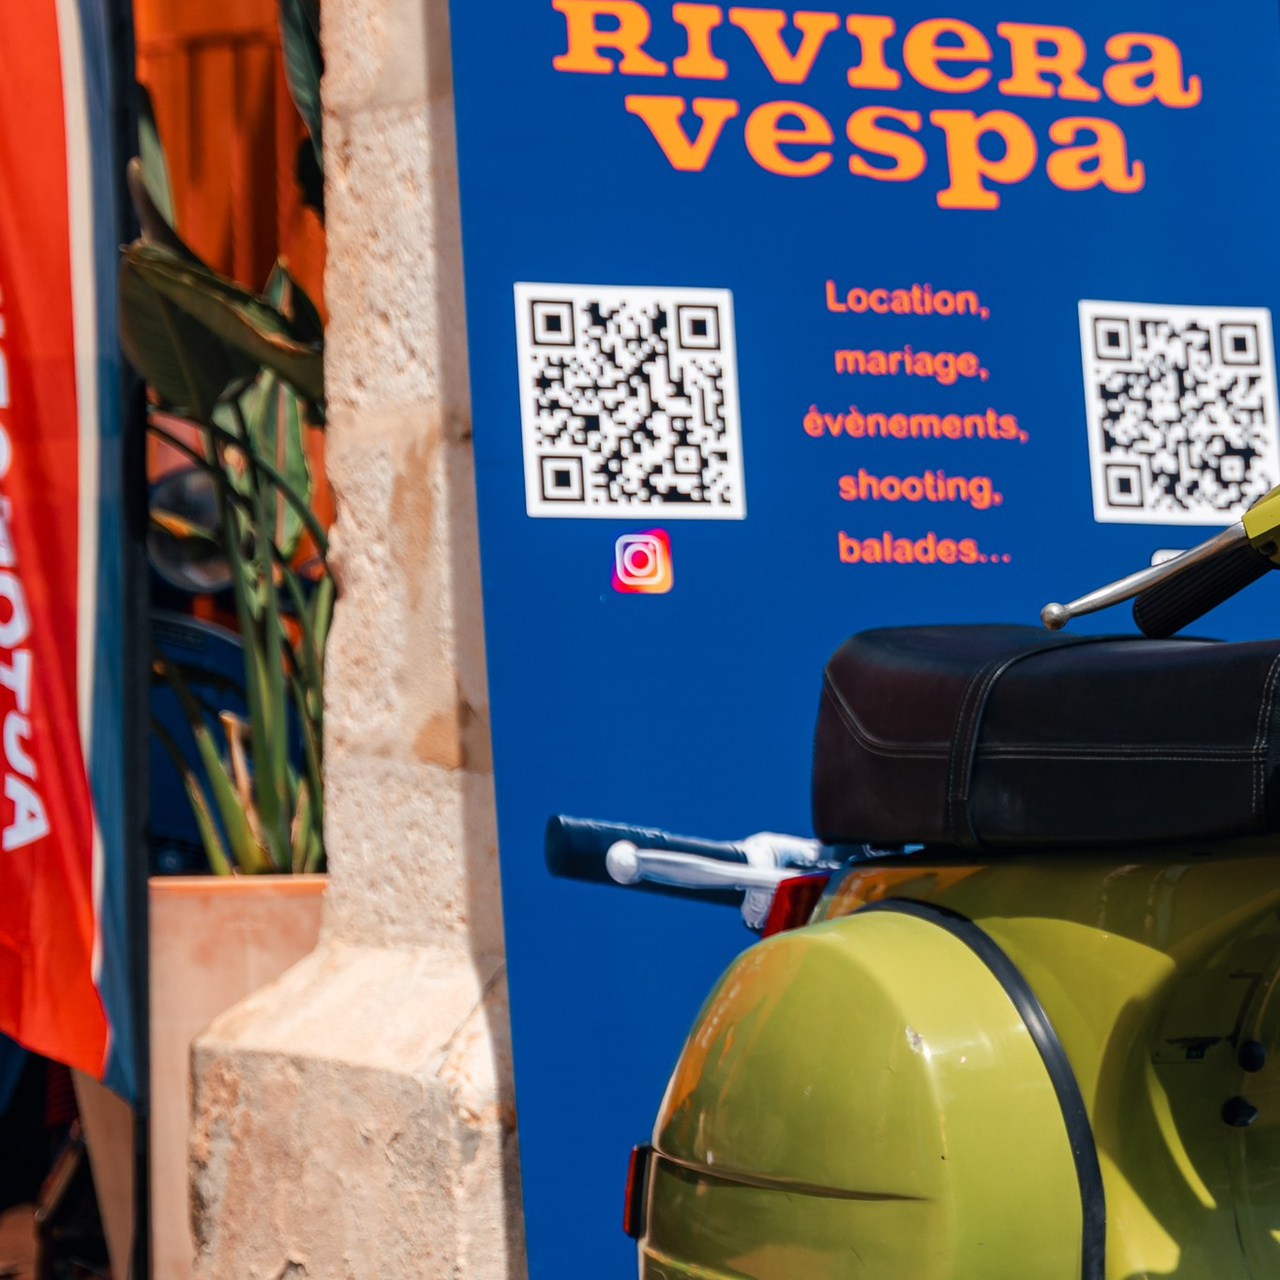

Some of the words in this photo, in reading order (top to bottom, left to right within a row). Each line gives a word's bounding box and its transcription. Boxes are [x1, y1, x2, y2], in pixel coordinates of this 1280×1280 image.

[825, 279, 991, 321] Location,
[834, 344, 990, 386] mariage,
[838, 468, 1004, 510] shooting,
[836, 530, 1012, 564] balades...
